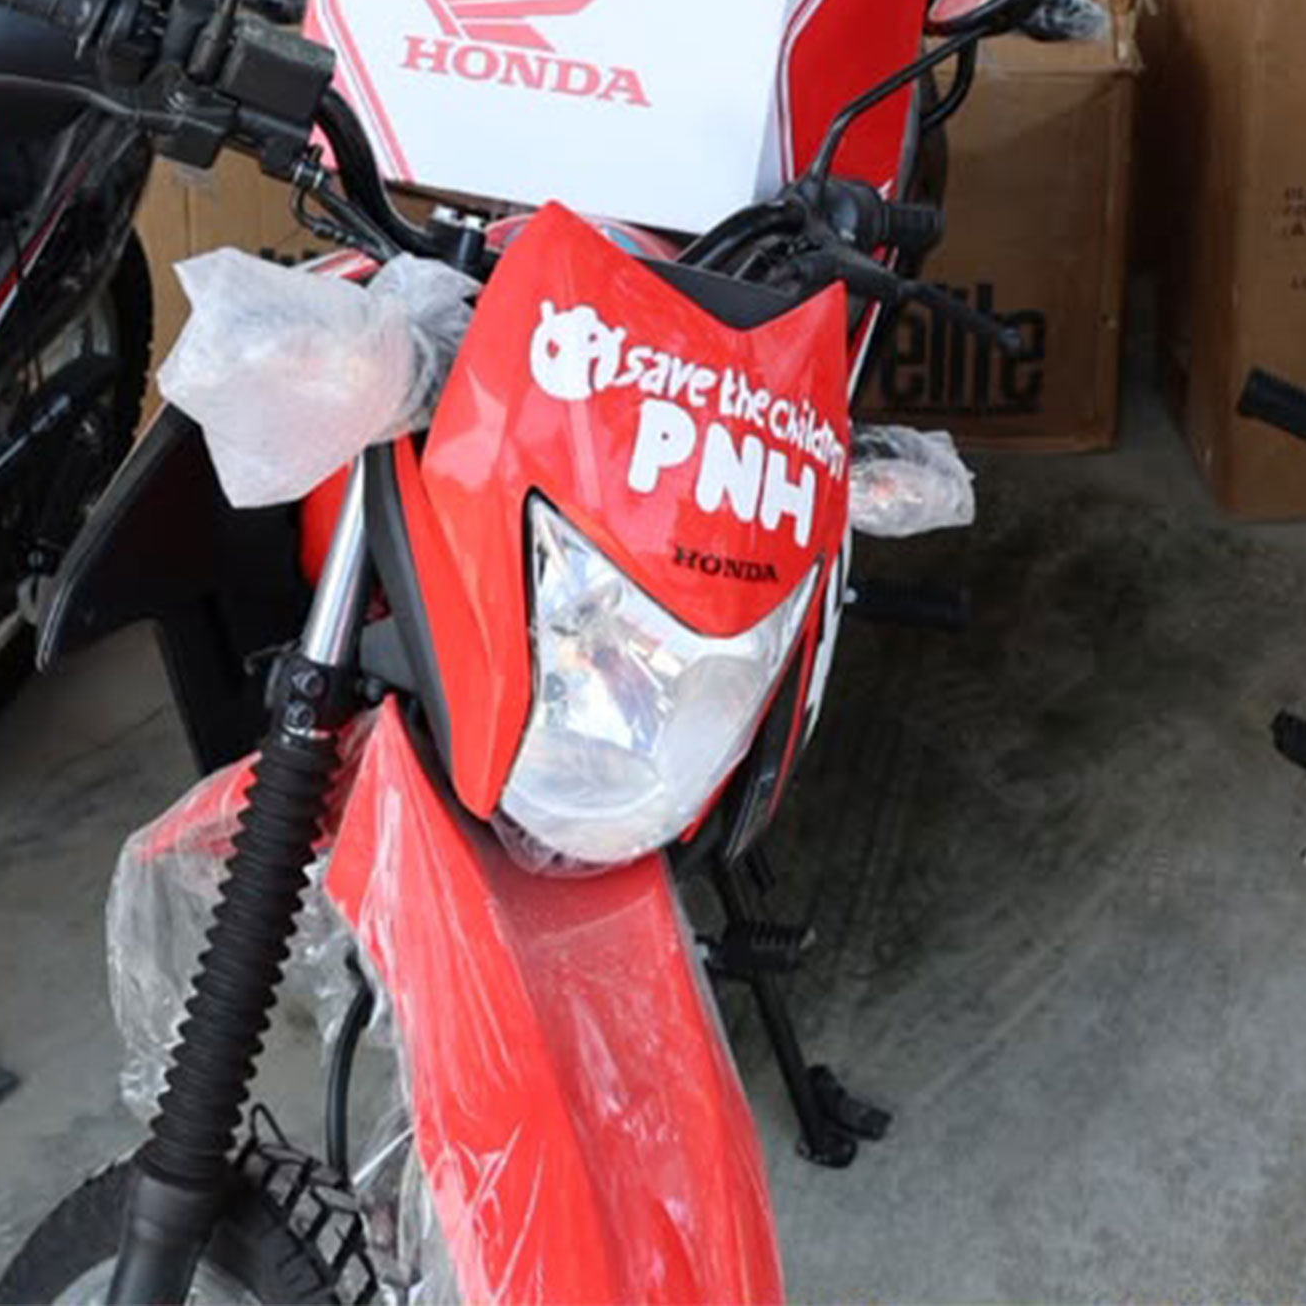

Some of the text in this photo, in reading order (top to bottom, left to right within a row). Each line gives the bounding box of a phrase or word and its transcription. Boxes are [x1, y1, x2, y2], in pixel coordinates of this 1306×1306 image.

[399, 34, 652, 108] HONDA
[719, 366, 770, 429] the
[627, 398, 817, 548] PNH
[670, 542, 779, 583] HONDA
